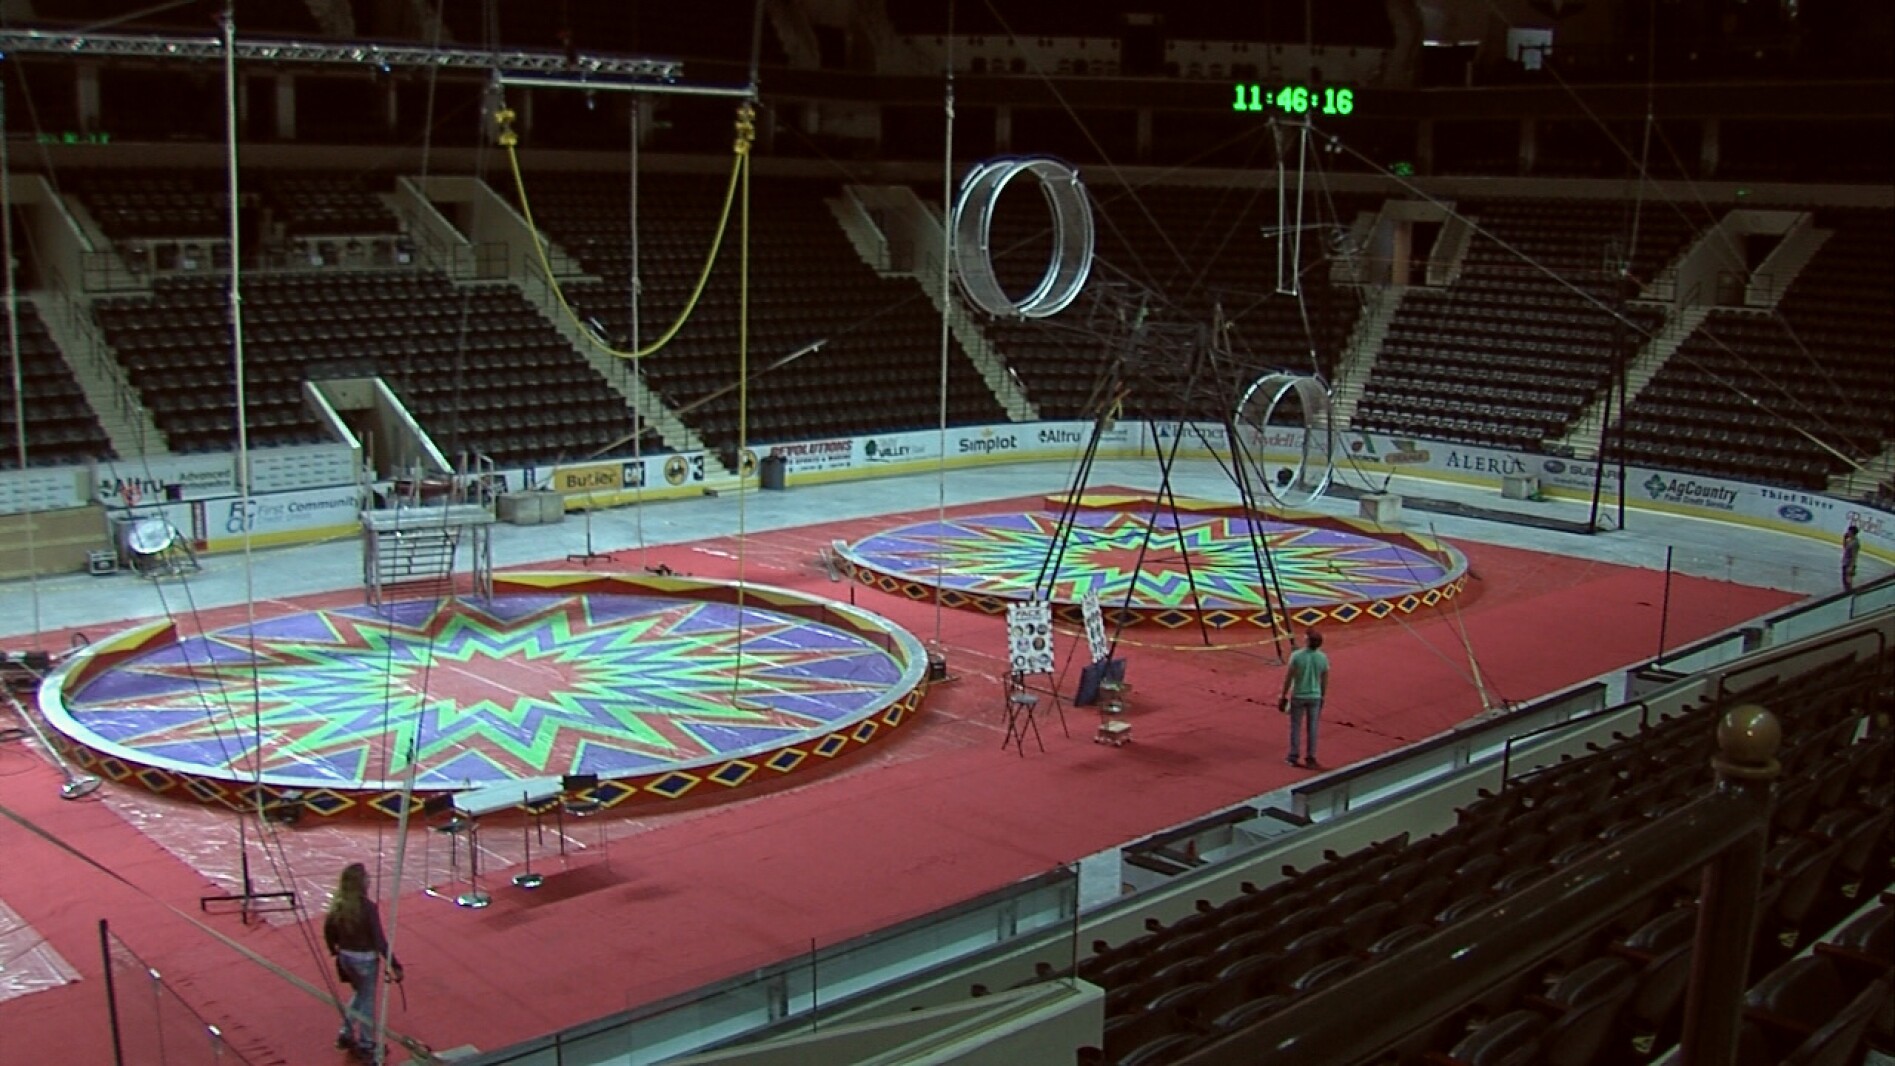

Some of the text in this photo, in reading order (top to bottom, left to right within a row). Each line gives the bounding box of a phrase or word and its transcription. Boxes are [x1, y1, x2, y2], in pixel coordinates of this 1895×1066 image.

[1233, 84, 1353, 115] 11:46:16
[959, 435, 1018, 454] Simplot
[1048, 429, 1081, 443] Altru
[566, 471, 616, 488] Butler
[1667, 479, 1738, 504] AgCountry
[1761, 489, 1834, 510] Thief River
